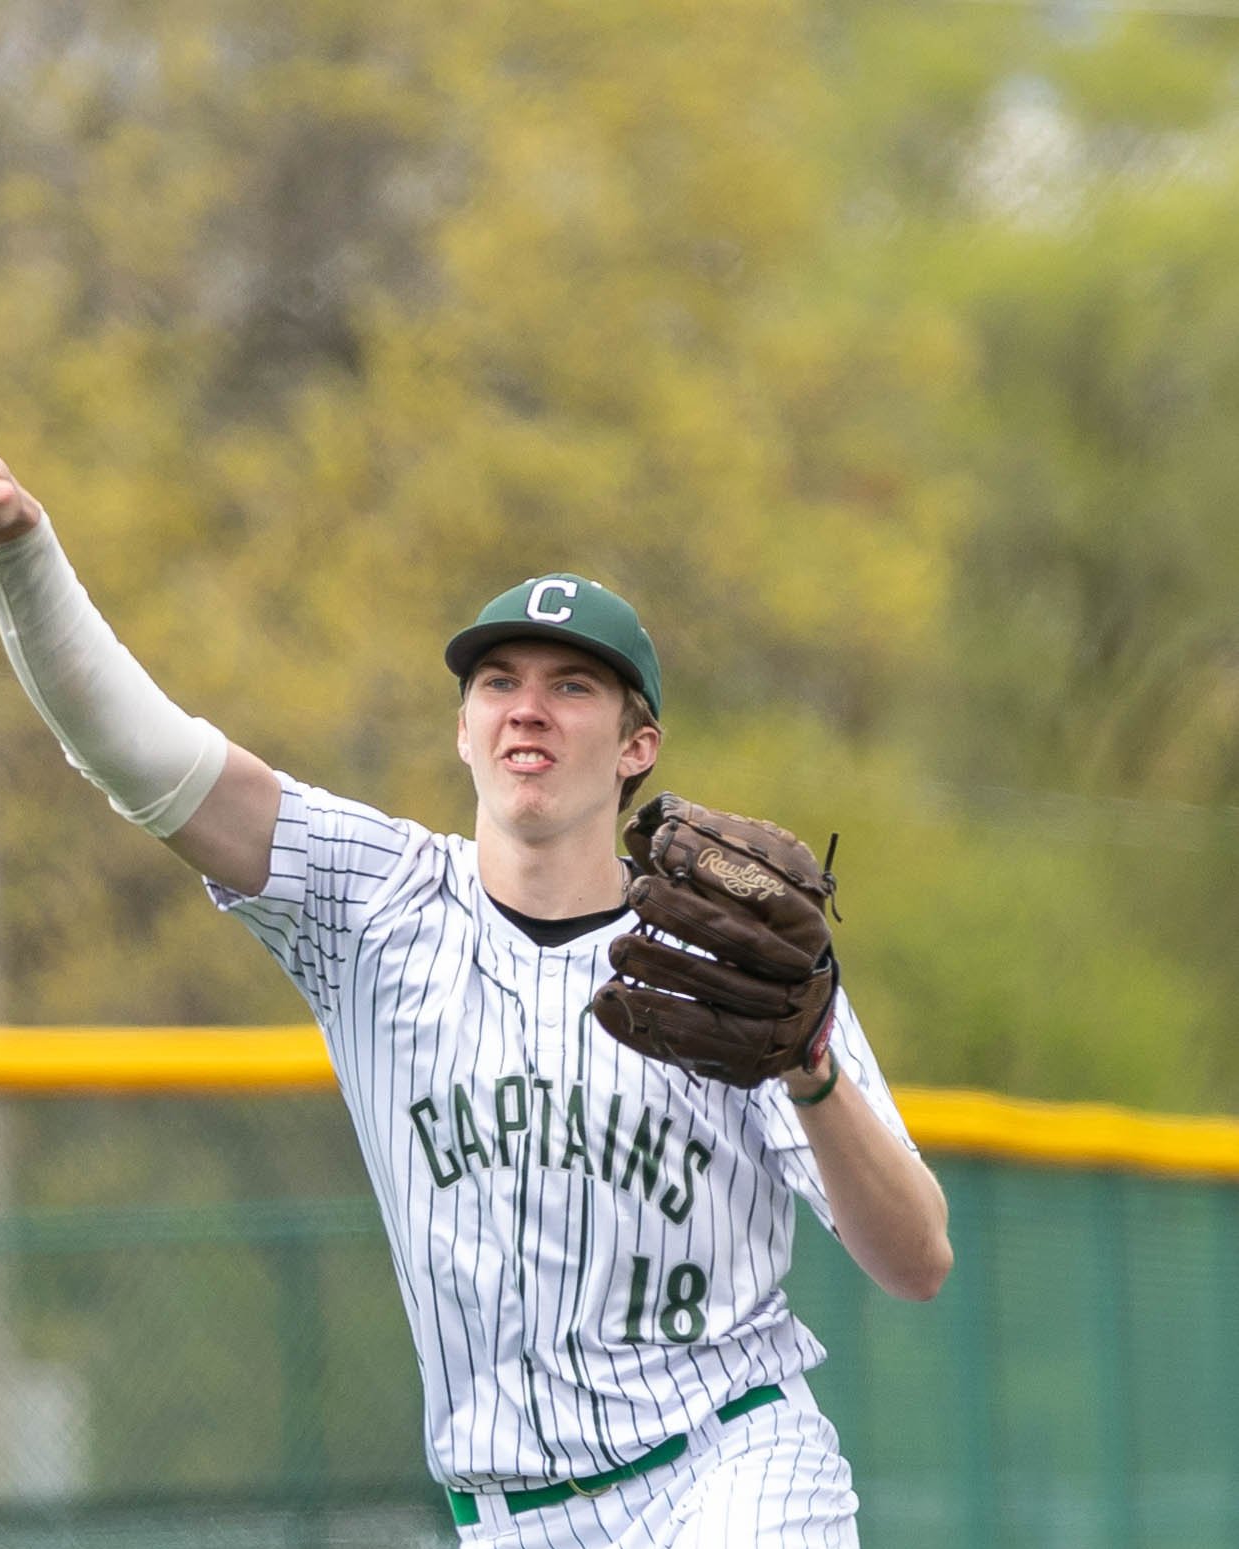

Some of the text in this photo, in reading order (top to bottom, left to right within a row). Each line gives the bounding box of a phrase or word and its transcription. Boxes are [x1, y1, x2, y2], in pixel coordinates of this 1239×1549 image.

[526, 578, 578, 624] C
[697, 847, 785, 901] Rawlings
[411, 1075, 711, 1225] CAPTAINS
[621, 1255, 708, 1344] 18
